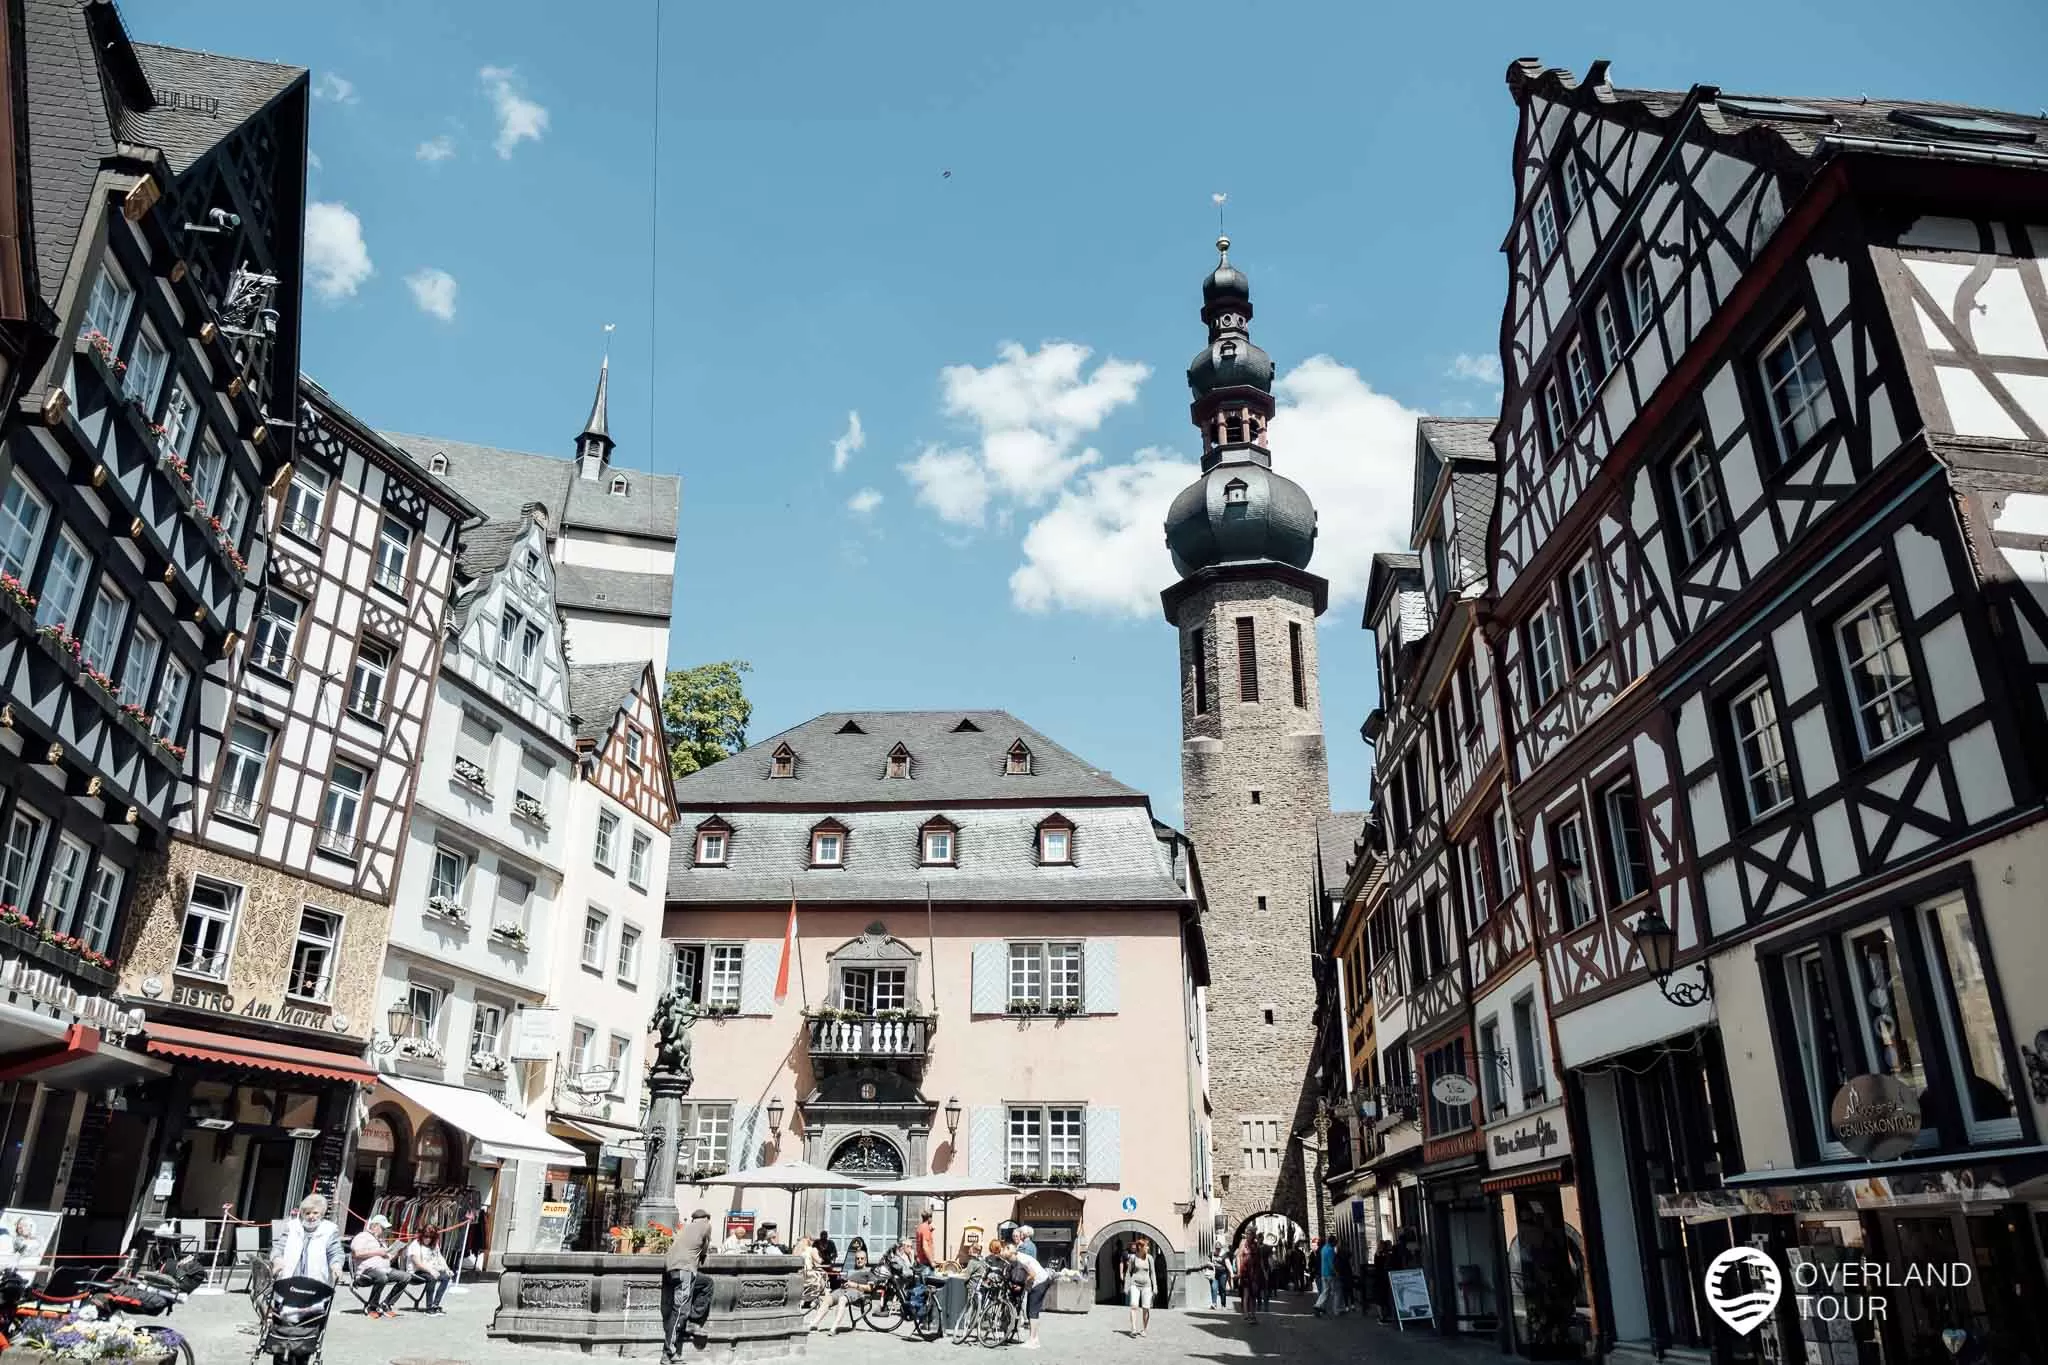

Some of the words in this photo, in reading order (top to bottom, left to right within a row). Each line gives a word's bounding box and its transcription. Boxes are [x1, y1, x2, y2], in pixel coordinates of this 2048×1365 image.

[171, 985, 235, 1012] BISTRO
[240, 996, 272, 1019] Am
[275, 1002, 330, 1030] Markt
[1839, 1112, 1914, 1137] GENUSSKONTOR
